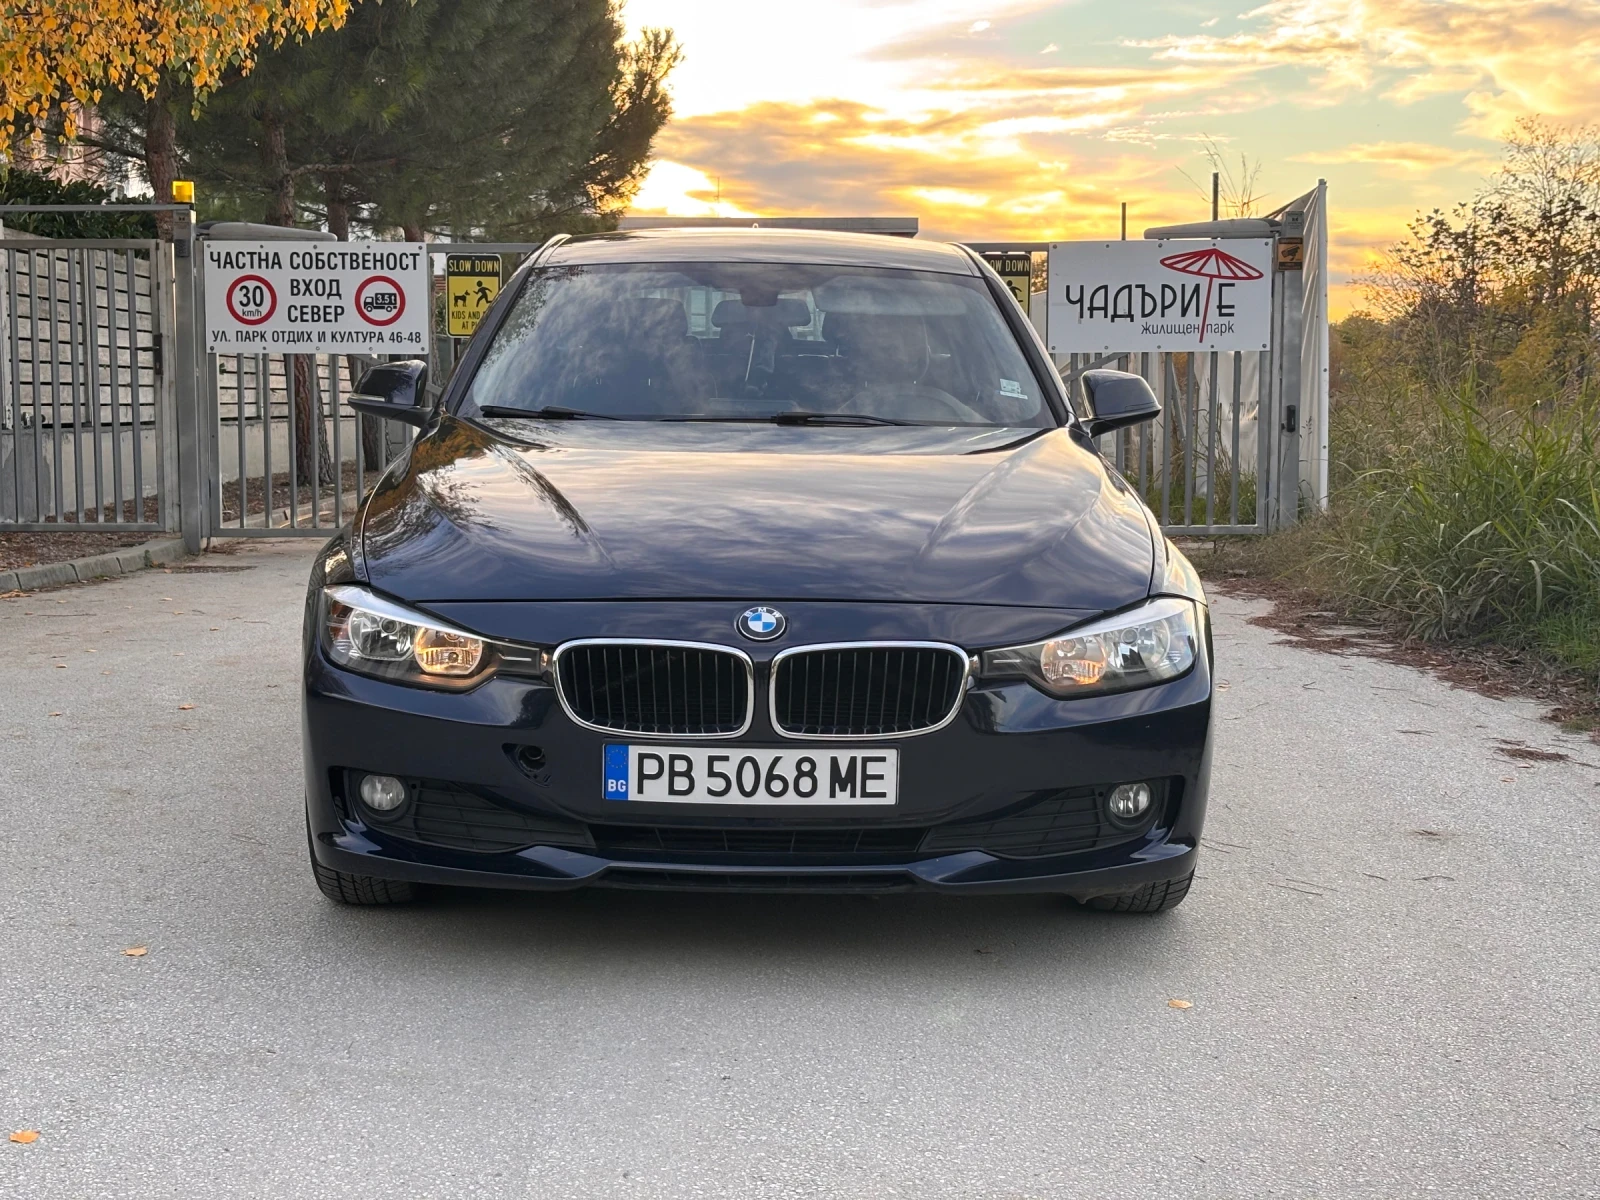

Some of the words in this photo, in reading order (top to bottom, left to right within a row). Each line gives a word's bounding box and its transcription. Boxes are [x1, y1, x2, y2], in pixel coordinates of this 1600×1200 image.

[209, 251, 283, 270] ЧАСТНА
[289, 251, 420, 271] СОБСТВЕНОСТ
[448, 260, 471, 272] SLOW
[475, 260, 499, 273] DOWN
[989, 260, 1003, 272] OW
[1005, 260, 1030, 272] DOWN
[239, 285, 265, 308] 30
[290, 279, 342, 300] ВХОД
[376, 294, 390, 304] 3.5
[1065, 283, 1236, 323] ЧАДЪРИТЕ
[241, 308, 262, 317] km/h
[287, 305, 345, 323] СЕВЕР
[451, 311, 466, 320] KIDS
[467, 311, 480, 320] AND
[462, 321, 469, 330] AT
[1141, 321, 1200, 335] жилищен
[1206, 321, 1235, 336] парк
[212, 331, 231, 342] УЛ.
[235, 331, 267, 342] ПАРК
[272, 331, 313, 345] ОТДИХ
[317, 331, 326, 343] И
[331, 331, 384, 343] КУЛТУРА
[388, 332, 421, 343] 46-48
[607, 779, 627, 792] BG
[706, 755, 818, 798] 5068
